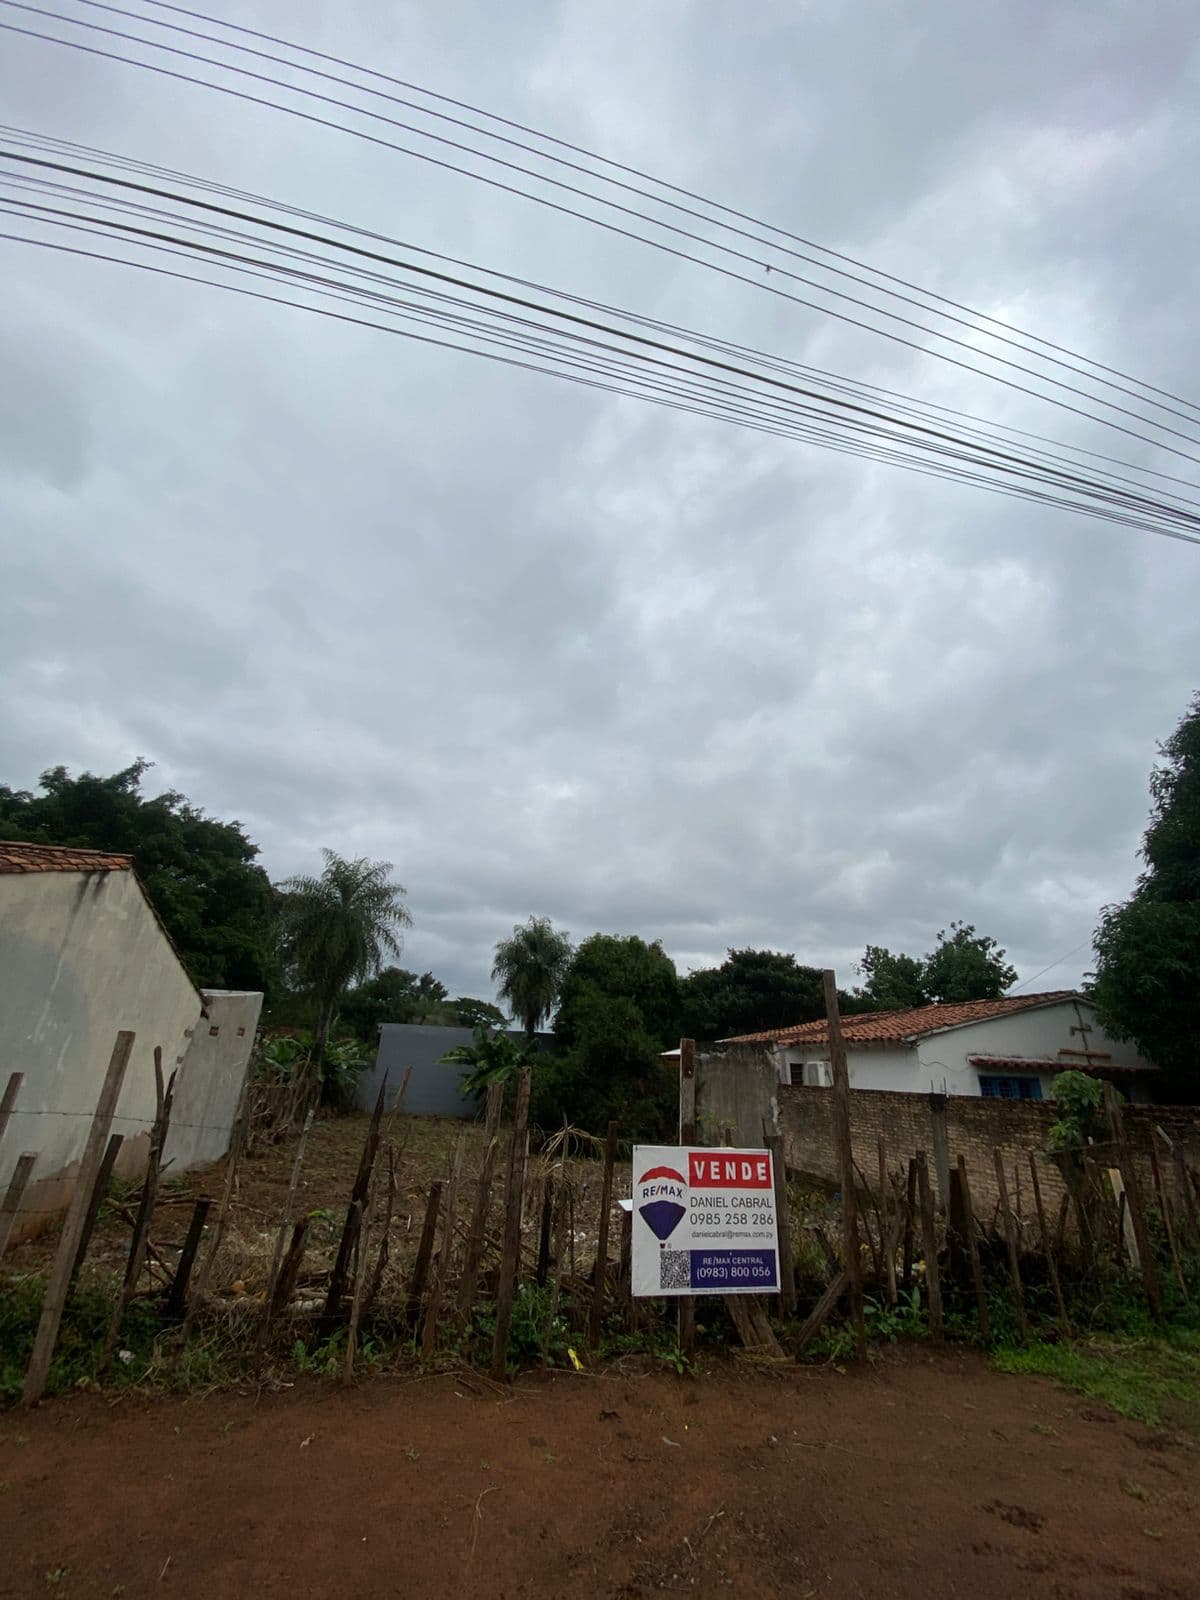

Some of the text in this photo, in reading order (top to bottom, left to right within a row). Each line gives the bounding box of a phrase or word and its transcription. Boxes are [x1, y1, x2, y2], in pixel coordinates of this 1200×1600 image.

[693, 1160, 767, 1181] VENDE
[643, 1185, 683, 1199] RE/MAX
[690, 1197, 772, 1208] DANIEL CABRAL
[689, 1213, 774, 1225] 0985 258 286
[703, 1256, 763, 1266] RE/MAX CENTRAL
[696, 1267, 771, 1280] (0983) 800 056
